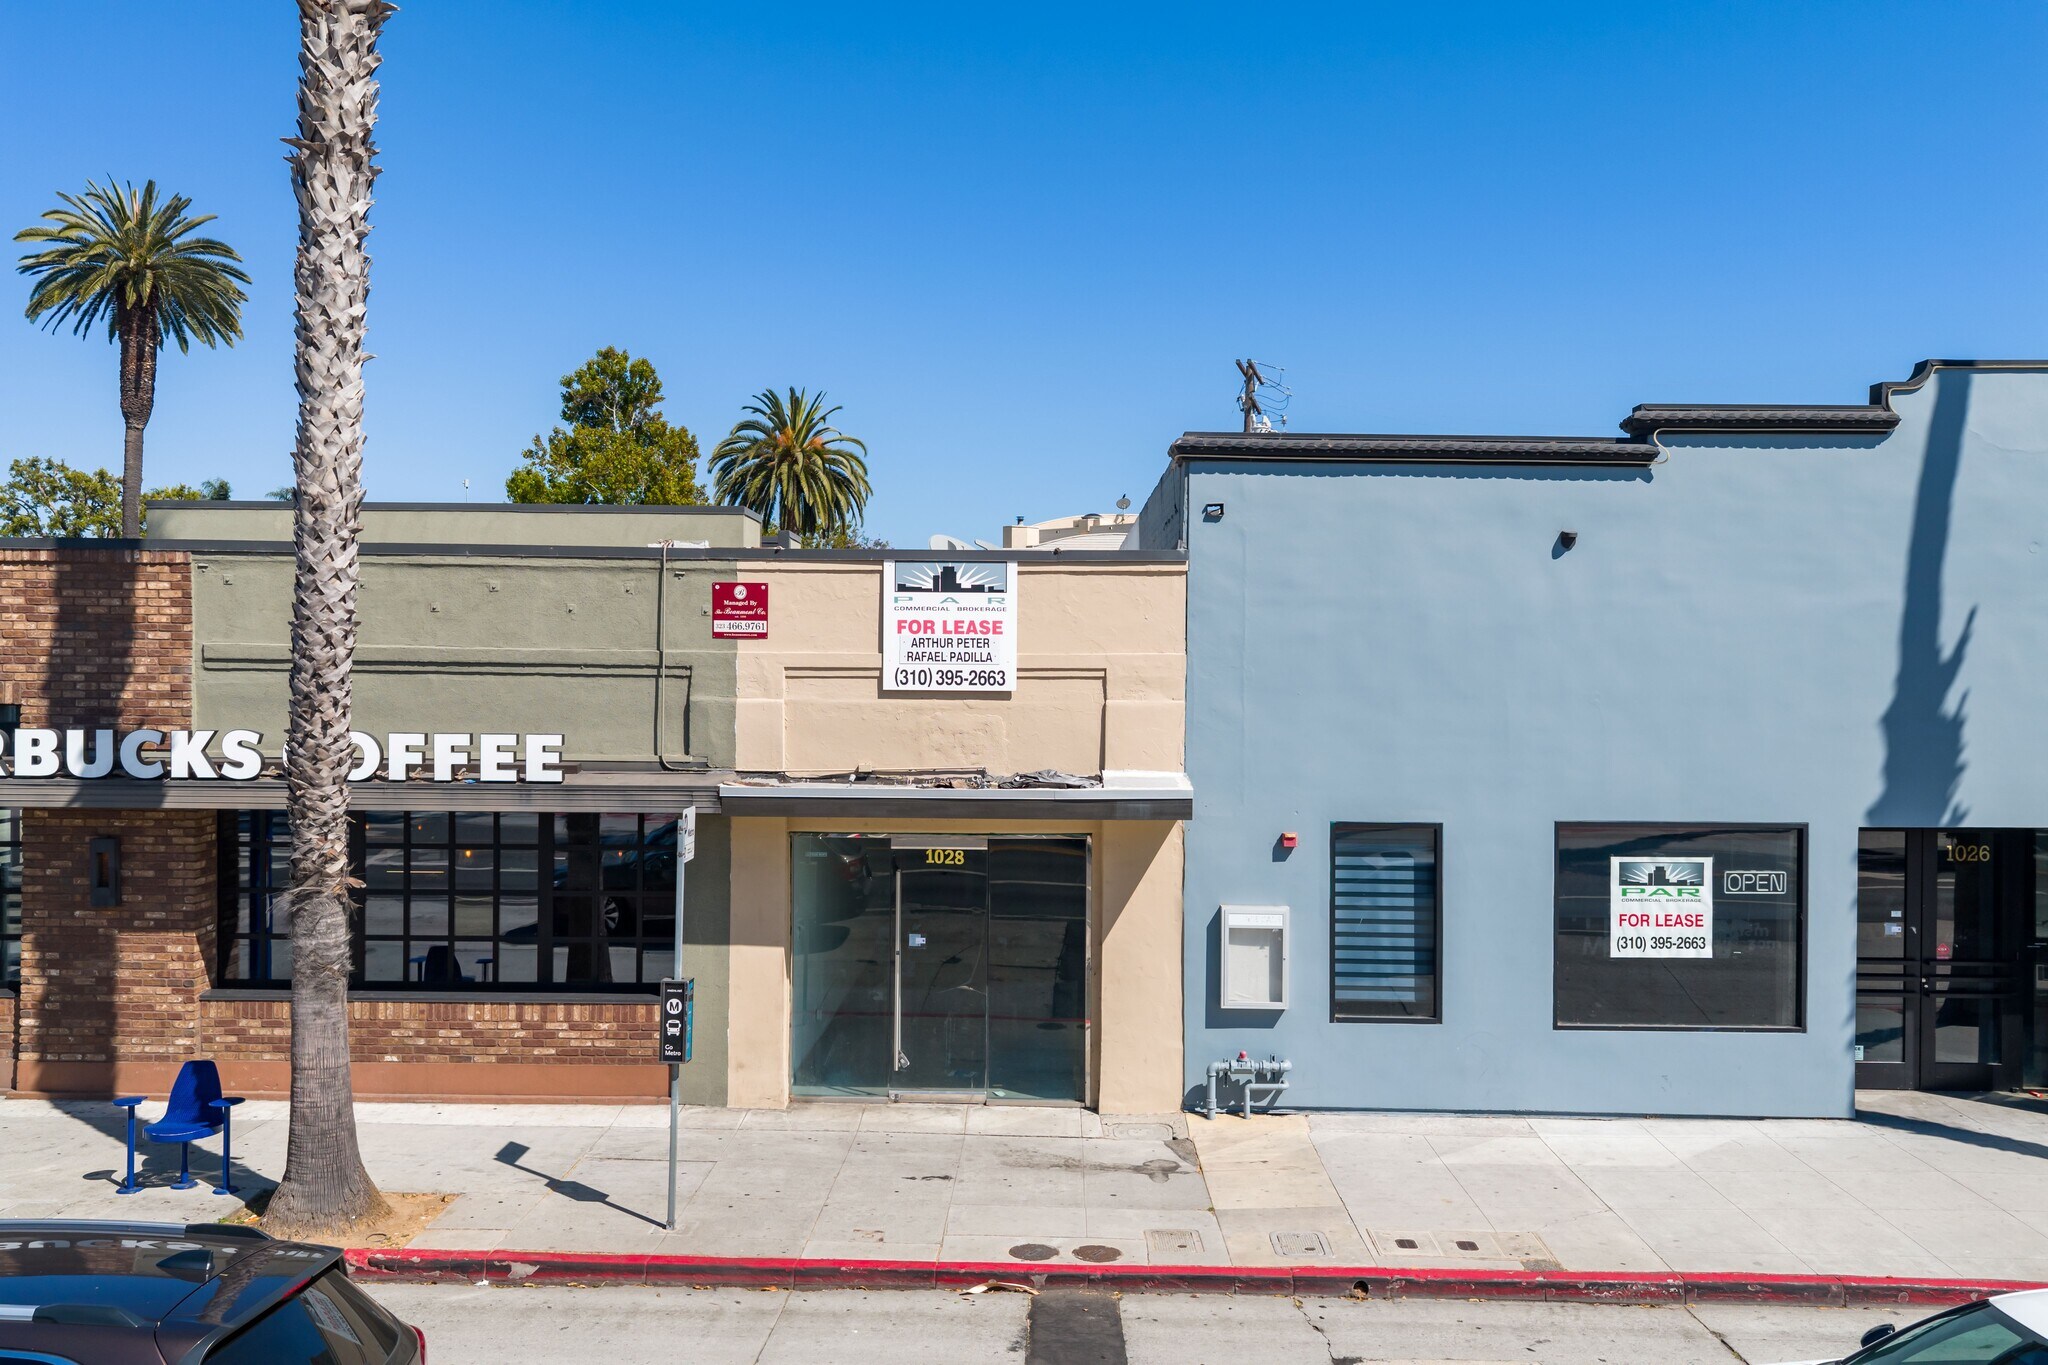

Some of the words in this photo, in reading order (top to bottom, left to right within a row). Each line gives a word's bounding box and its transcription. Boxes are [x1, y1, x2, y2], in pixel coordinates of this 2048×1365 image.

[727, 622, 765, 631] 466.9761
[897, 619, 935, 634] FOR
[942, 620, 1003, 635] LEASE
[911, 638, 954, 648] ARTHUR
[957, 638, 990, 648] PETER
[907, 652, 946, 662] RAFAEL
[950, 652, 992, 662] PADILLA
[894, 667, 932, 687] (310)
[936, 670, 1006, 686] 395-2663
[0, 728, 263, 779] BUCKS
[282, 731, 564, 783] OFFEE
[926, 848, 964, 864] 1028
[1946, 845, 1990, 862] 1026
[1728, 874, 1784, 892] OPEN
[1622, 888, 1700, 897] PAR
[1619, 914, 1650, 927] FOR
[1656, 914, 1704, 928] LEASE
[1616, 936, 1646, 952] (310)
[1650, 936, 1706, 950] 395-2663
[670, 1002, 680, 1012] M
